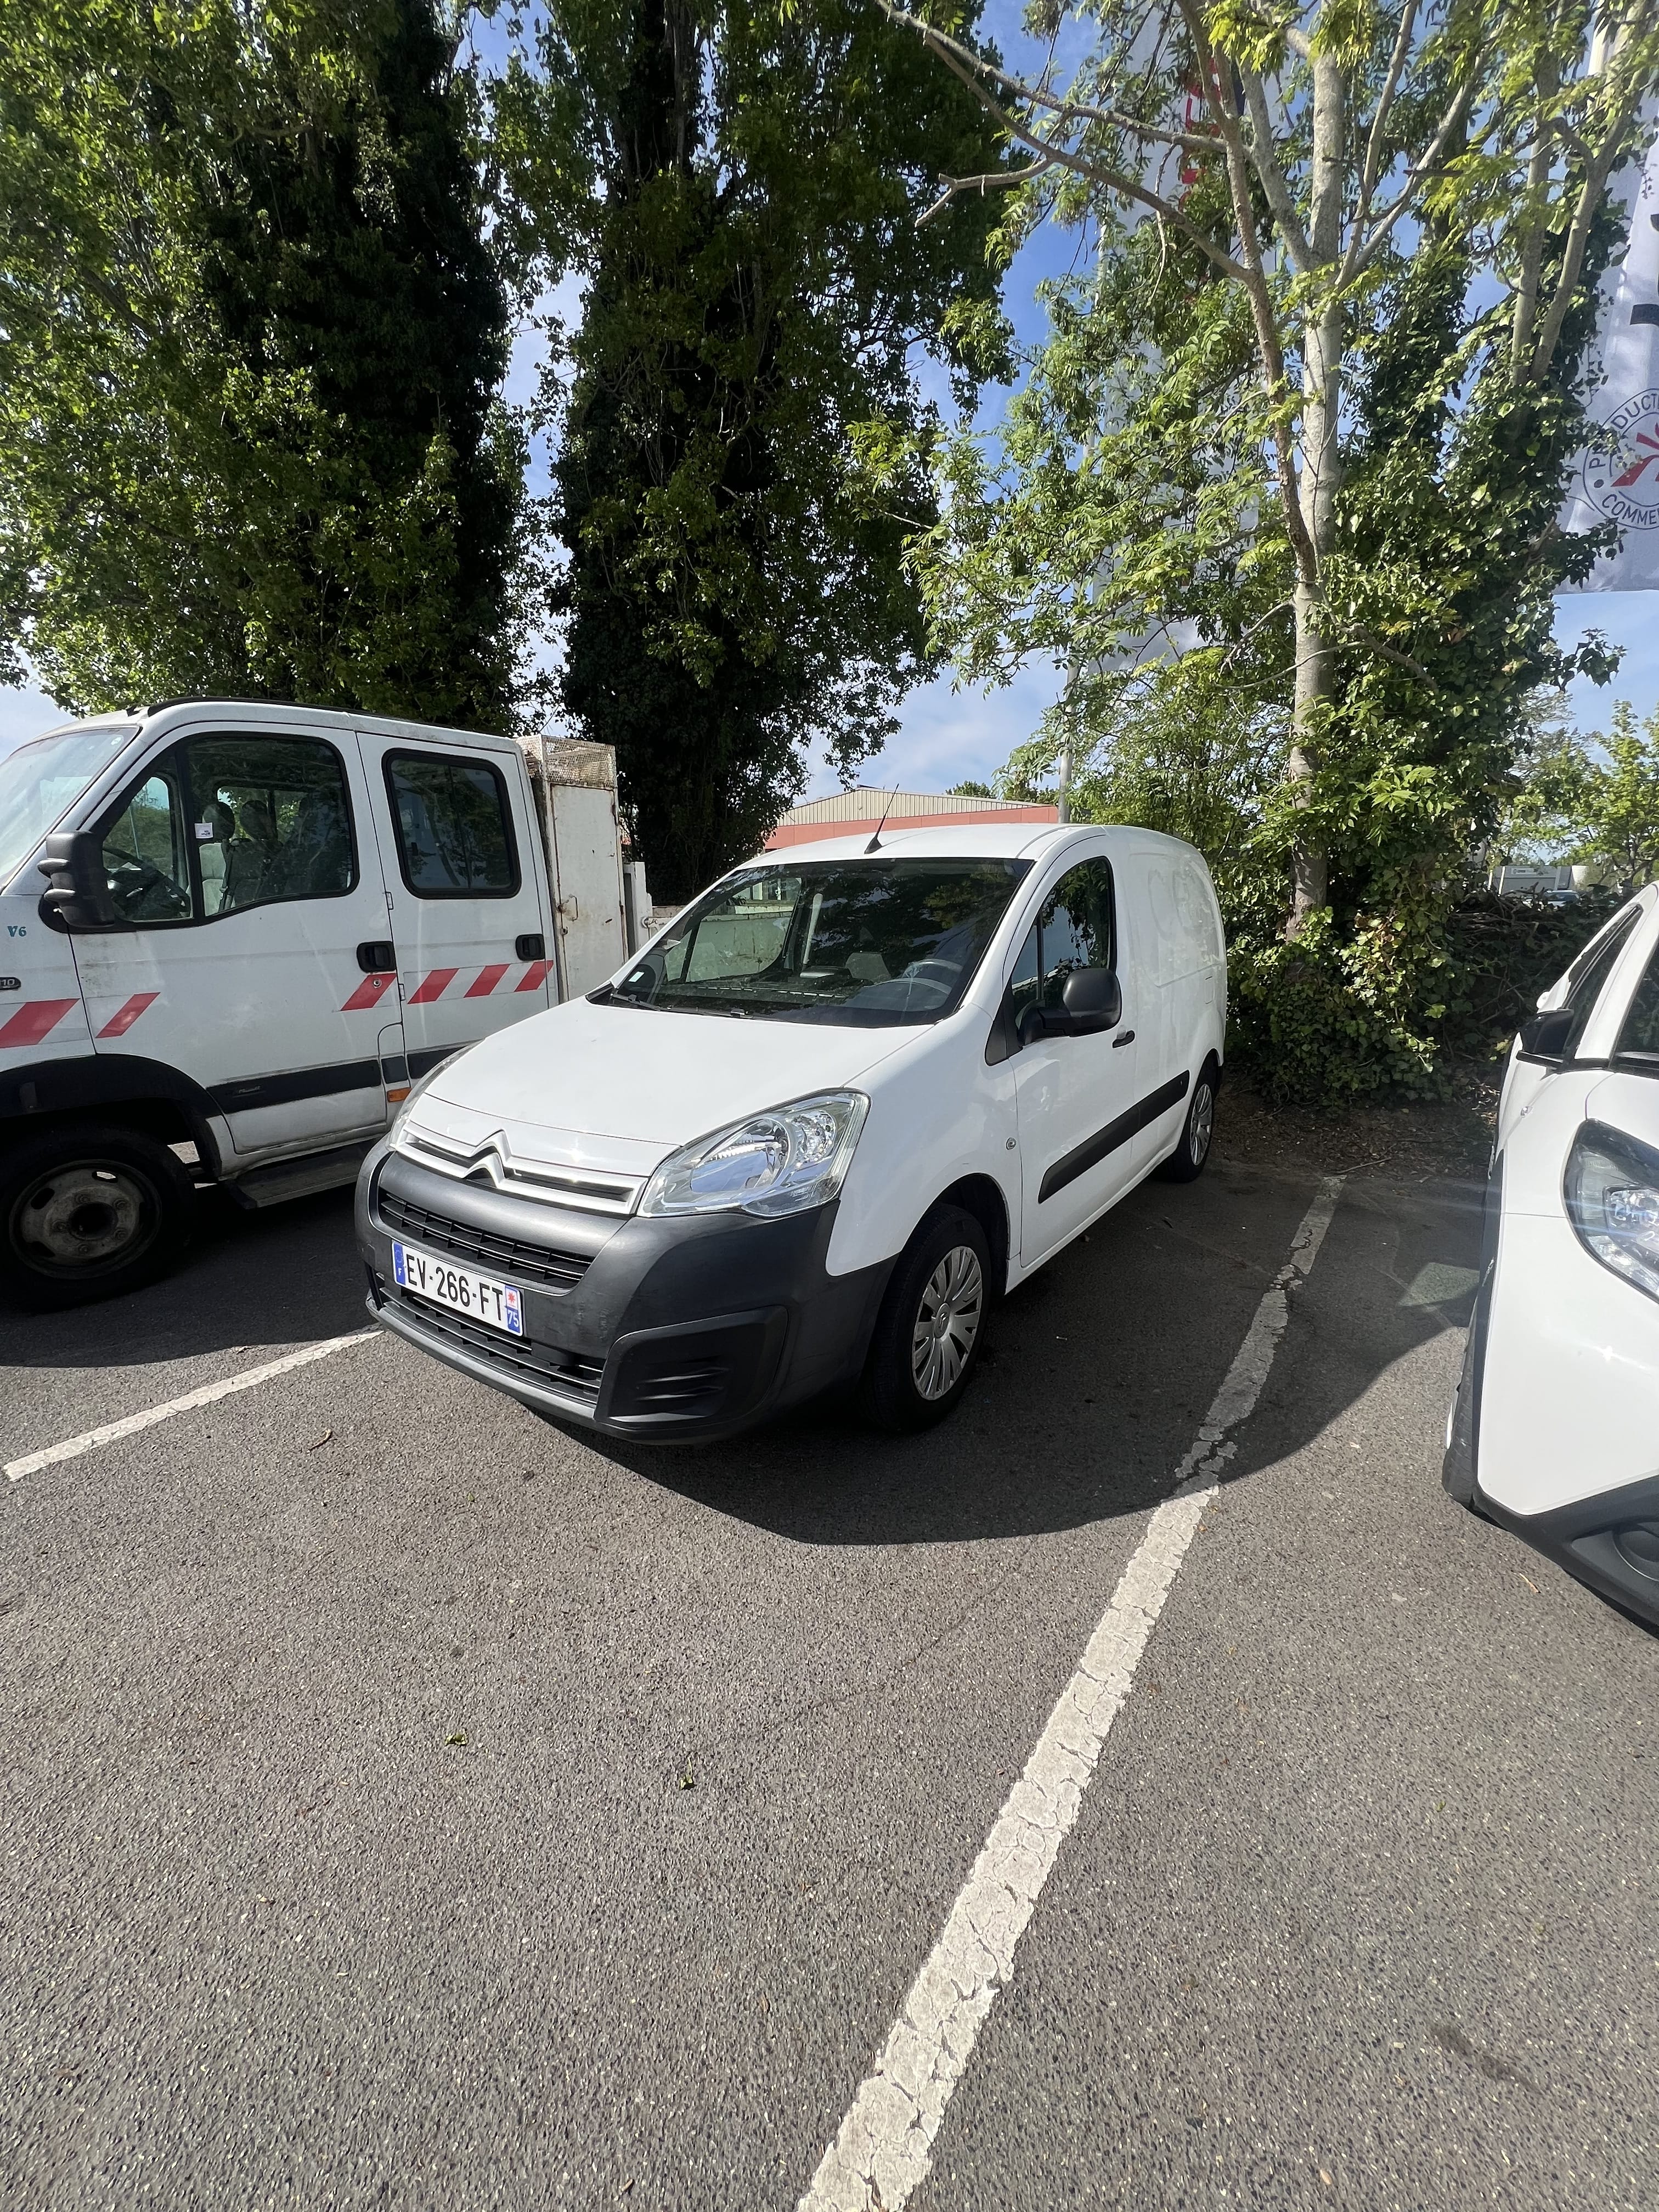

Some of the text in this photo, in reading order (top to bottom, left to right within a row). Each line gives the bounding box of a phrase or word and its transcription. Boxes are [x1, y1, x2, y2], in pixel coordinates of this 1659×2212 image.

[1589, 392, 1659, 469] PDUCT
[1602, 494, 1659, 526] COMME
[7, 926, 27, 937] V6
[398, 1267, 402, 1276] F
[406, 1254, 503, 1321] EV-266-FT
[508, 1309, 519, 1328] 75
